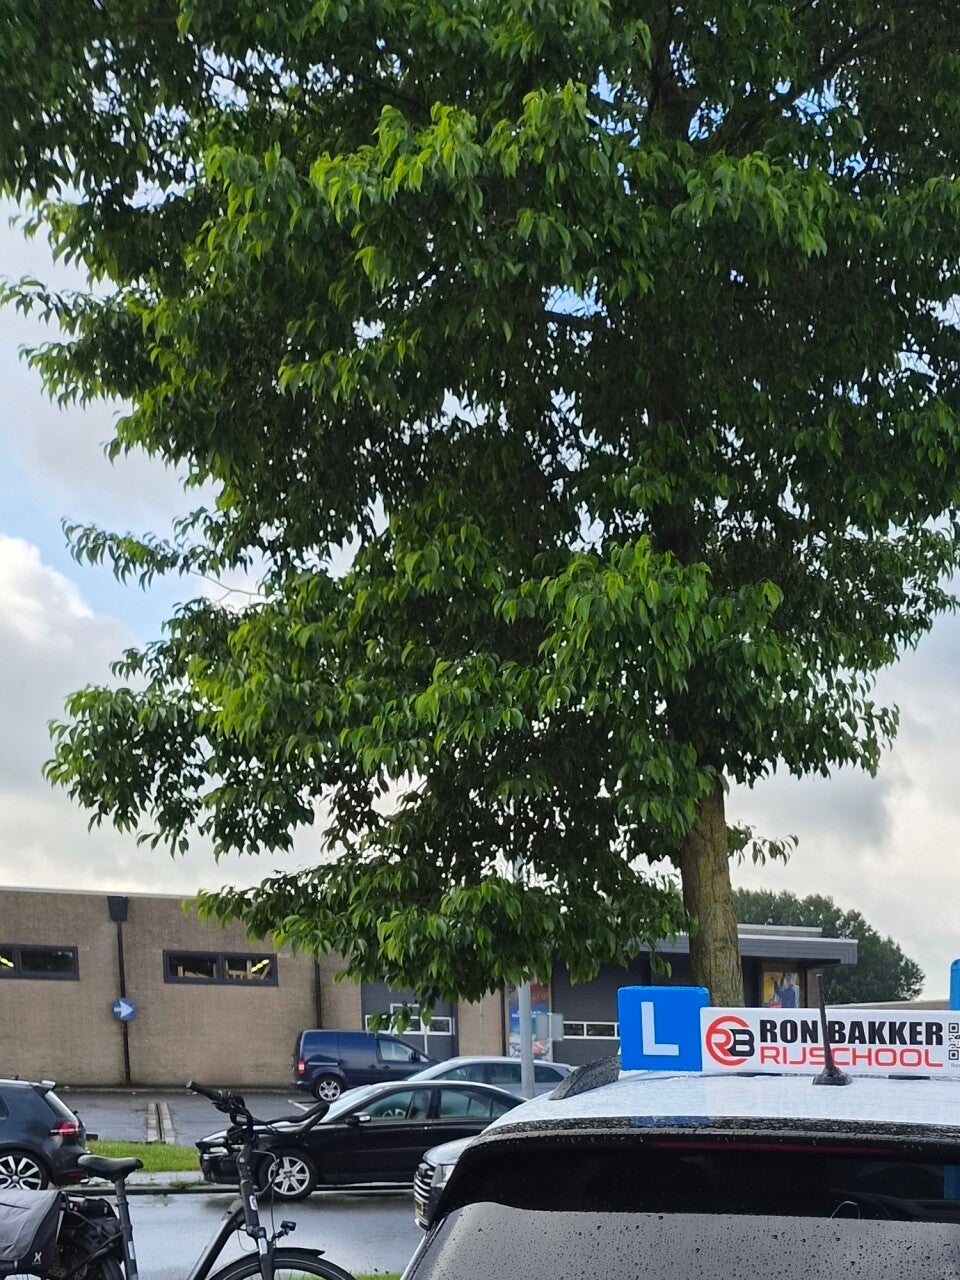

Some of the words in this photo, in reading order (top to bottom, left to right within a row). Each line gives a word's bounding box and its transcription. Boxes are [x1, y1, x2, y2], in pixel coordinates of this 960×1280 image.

[641, 1001, 680, 1056] L
[759, 1019, 818, 1043] RON
[827, 1020, 943, 1046] BAKKER
[760, 1046, 943, 1068] RIJSCHOOL
